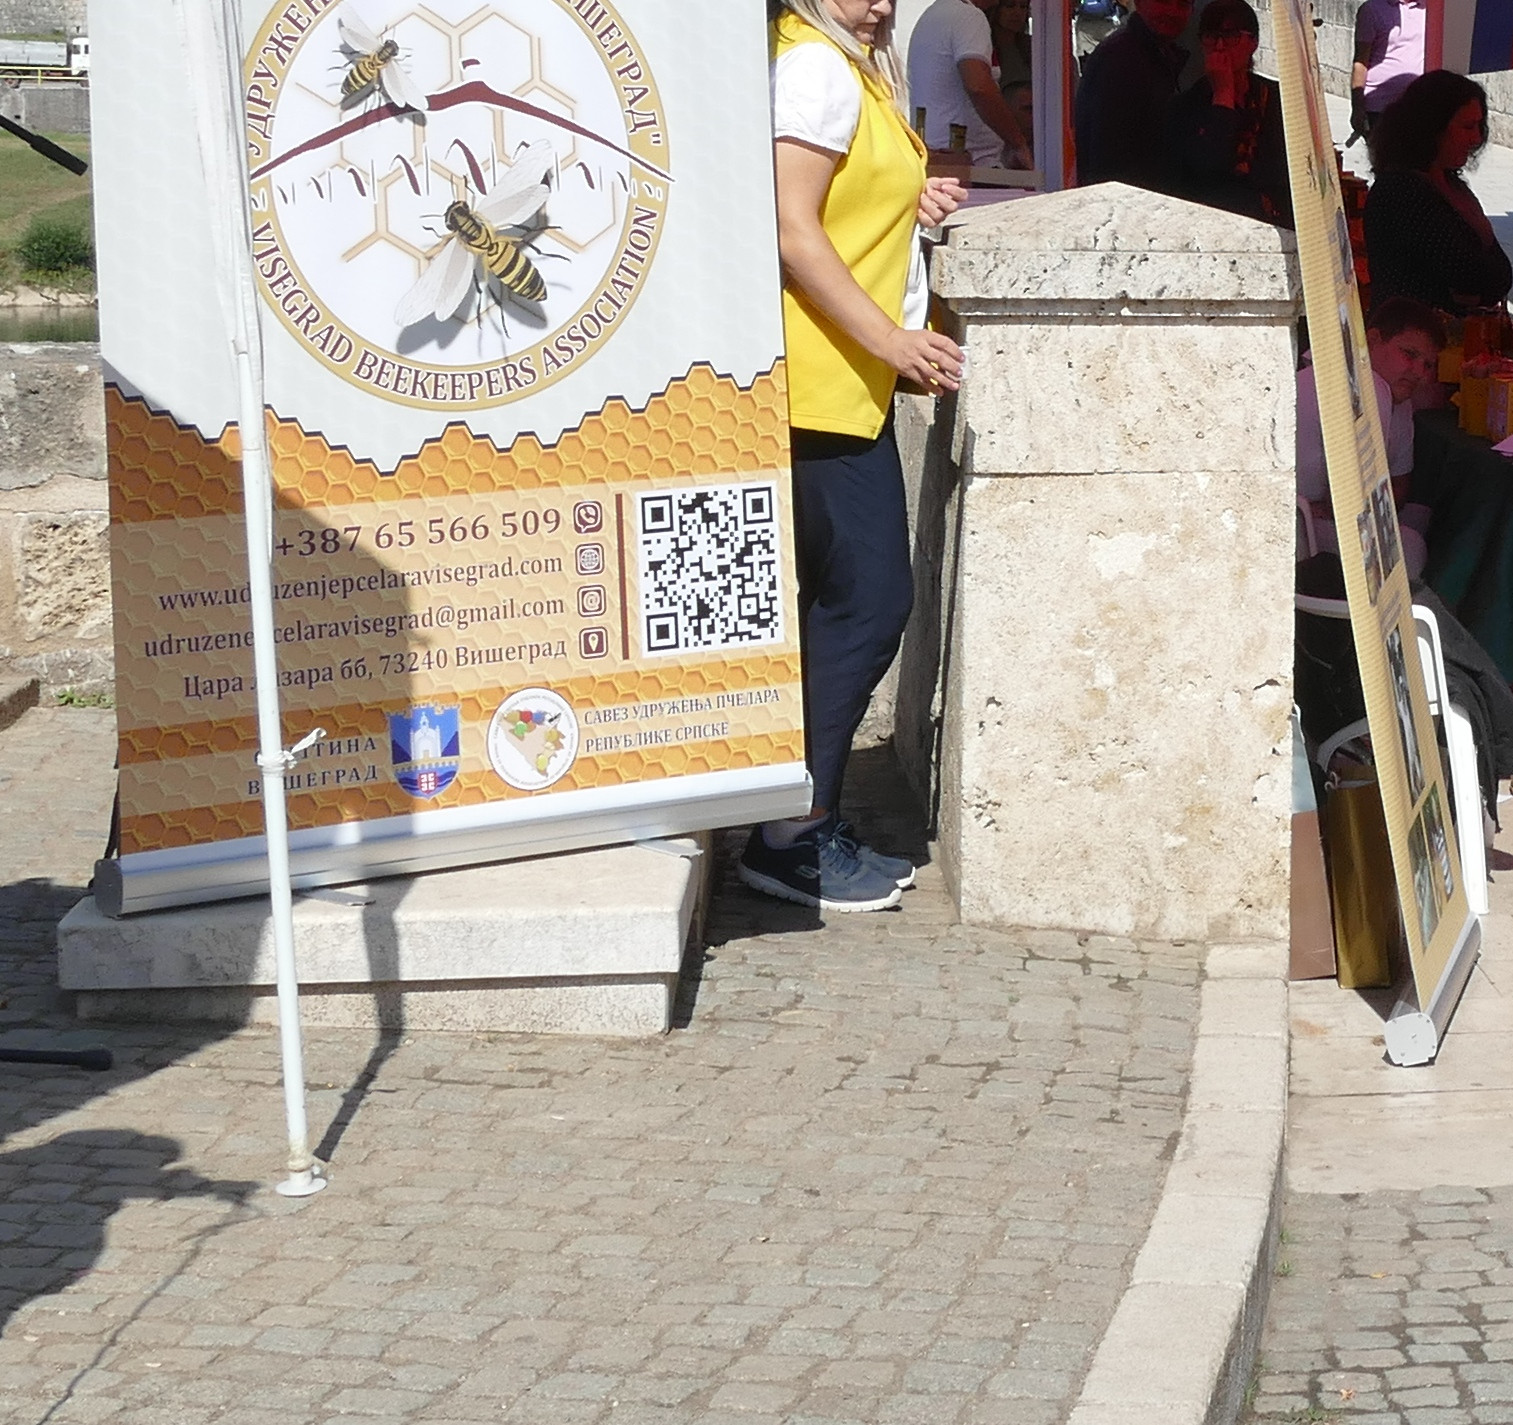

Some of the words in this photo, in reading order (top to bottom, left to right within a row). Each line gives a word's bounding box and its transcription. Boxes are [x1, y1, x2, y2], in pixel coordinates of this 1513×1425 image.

[252, 221, 354, 364] VISEGRAD
[352, 347, 537, 402] BEEKEEPERS
[542, 204, 660, 377] ASSOCIATION
[275, 525, 363, 557] +387
[375, 520, 415, 549] 65
[428, 514, 490, 546] 566
[501, 508, 561, 539] 509
[144, 598, 565, 658] udruzenecelaravisegrad@gmail.com
[184, 674, 244, 701] Цара
[249, 664, 333, 690] зара
[379, 647, 449, 677] 73240
[455, 639, 568, 668] Вишеград
[584, 706, 630, 726] САВЕЗ
[632, 698, 713, 721] УДРУЖЕЊА
[716, 687, 781, 710] ПЧЕЛАРА
[585, 728, 672, 753] РЕПУБЛИКЕ
[675, 721, 729, 742] СРПСКЕ
[247, 764, 378, 796] ВШЕГРАД
